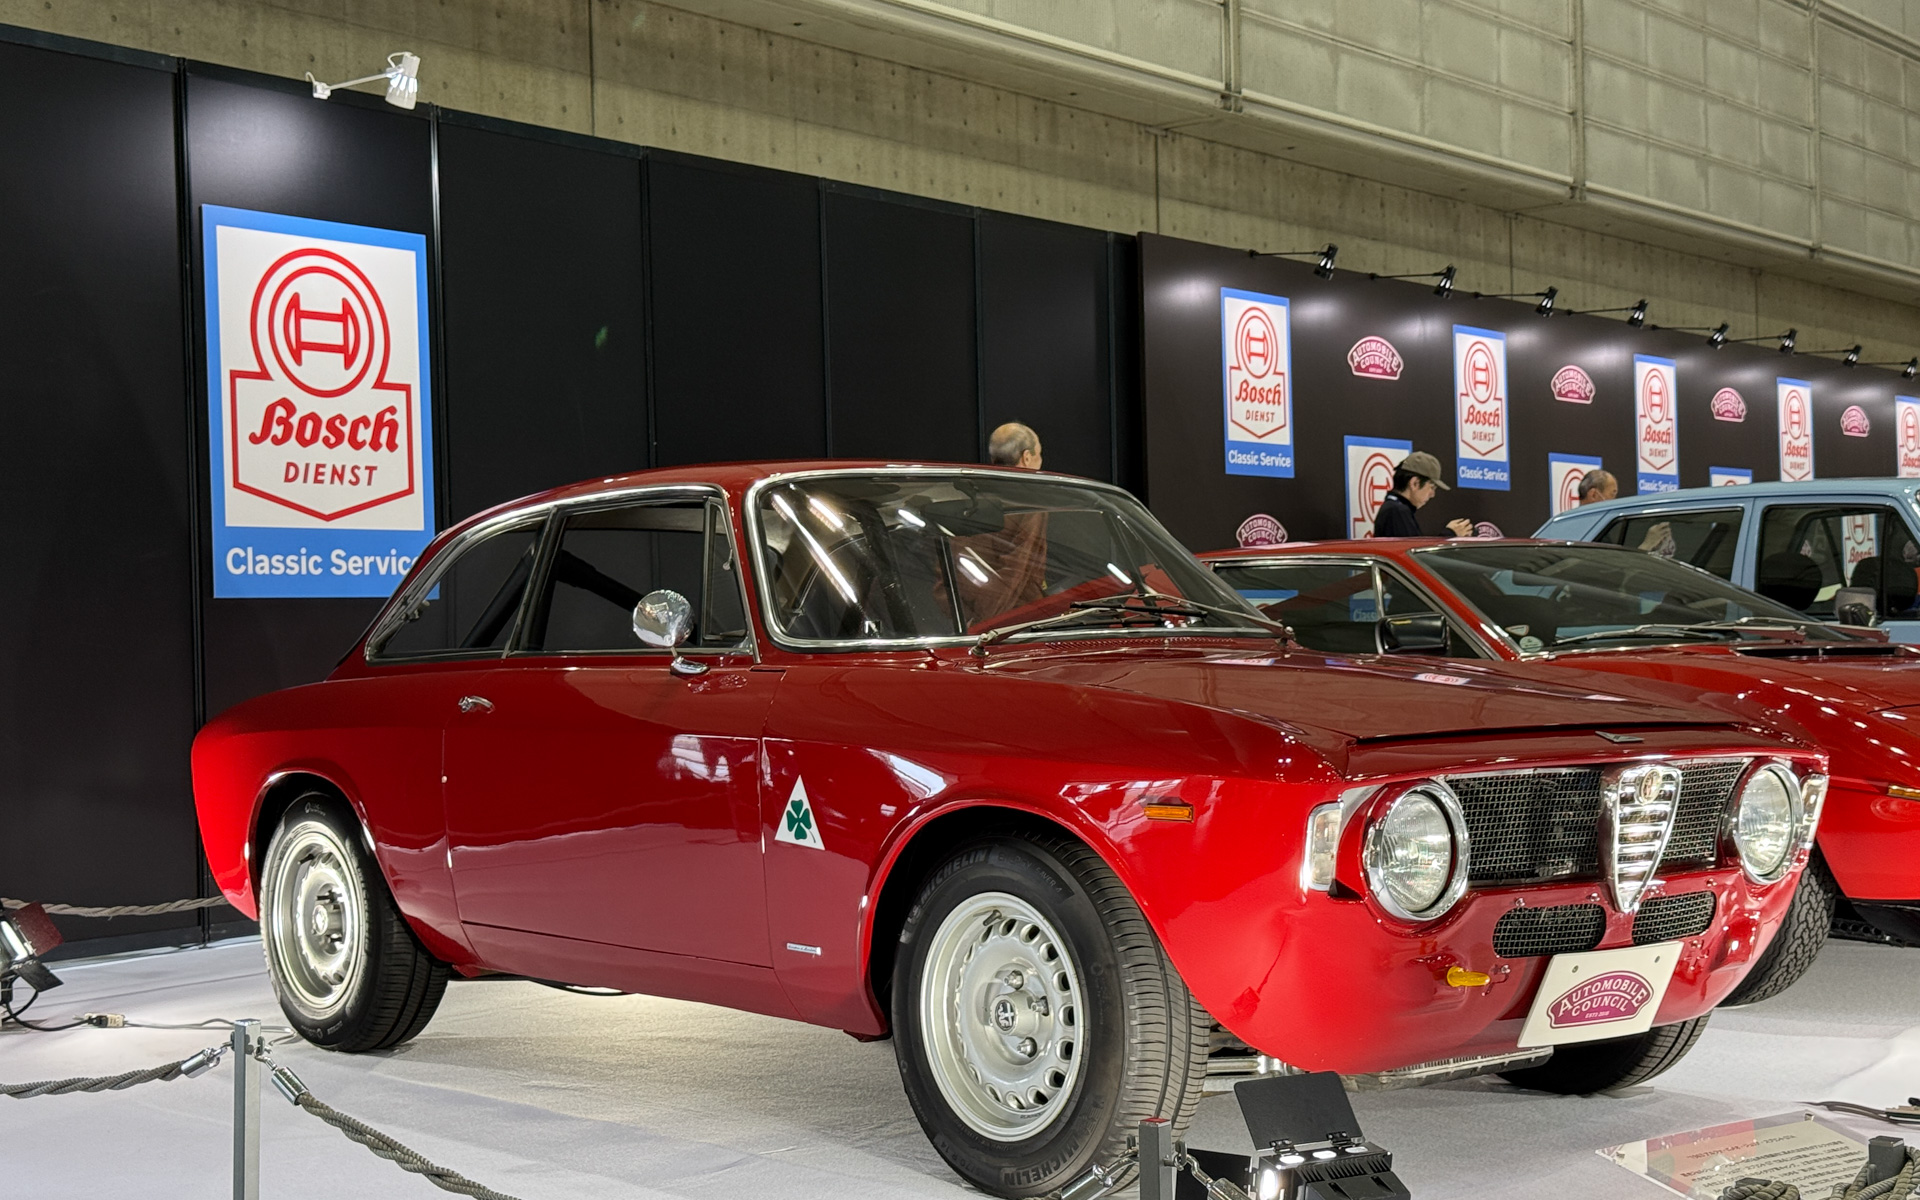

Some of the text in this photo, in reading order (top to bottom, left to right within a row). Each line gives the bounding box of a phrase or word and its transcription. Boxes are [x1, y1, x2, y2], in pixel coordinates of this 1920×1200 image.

[1352, 341, 1399, 372] AUTOMOBILE
[1360, 355, 1391, 373] COUNCIL
[1235, 378, 1282, 406] Bosch
[248, 397, 399, 453] Bosch
[1245, 409, 1276, 423] DIENST
[1464, 404, 1501, 428] Bosch
[1228, 449, 1292, 468] Classic Service
[283, 461, 378, 486] DIENST
[1241, 519, 1284, 543] AUTOMOBILE
[226, 547, 418, 576] Classic Servic
[920, 849, 988, 905] MICHELIN
[1558, 978, 1648, 1018] AUTOMOBILE
[1571, 995, 1629, 1017] COUNCIL
[1003, 1134, 1080, 1186] MICHELIN
